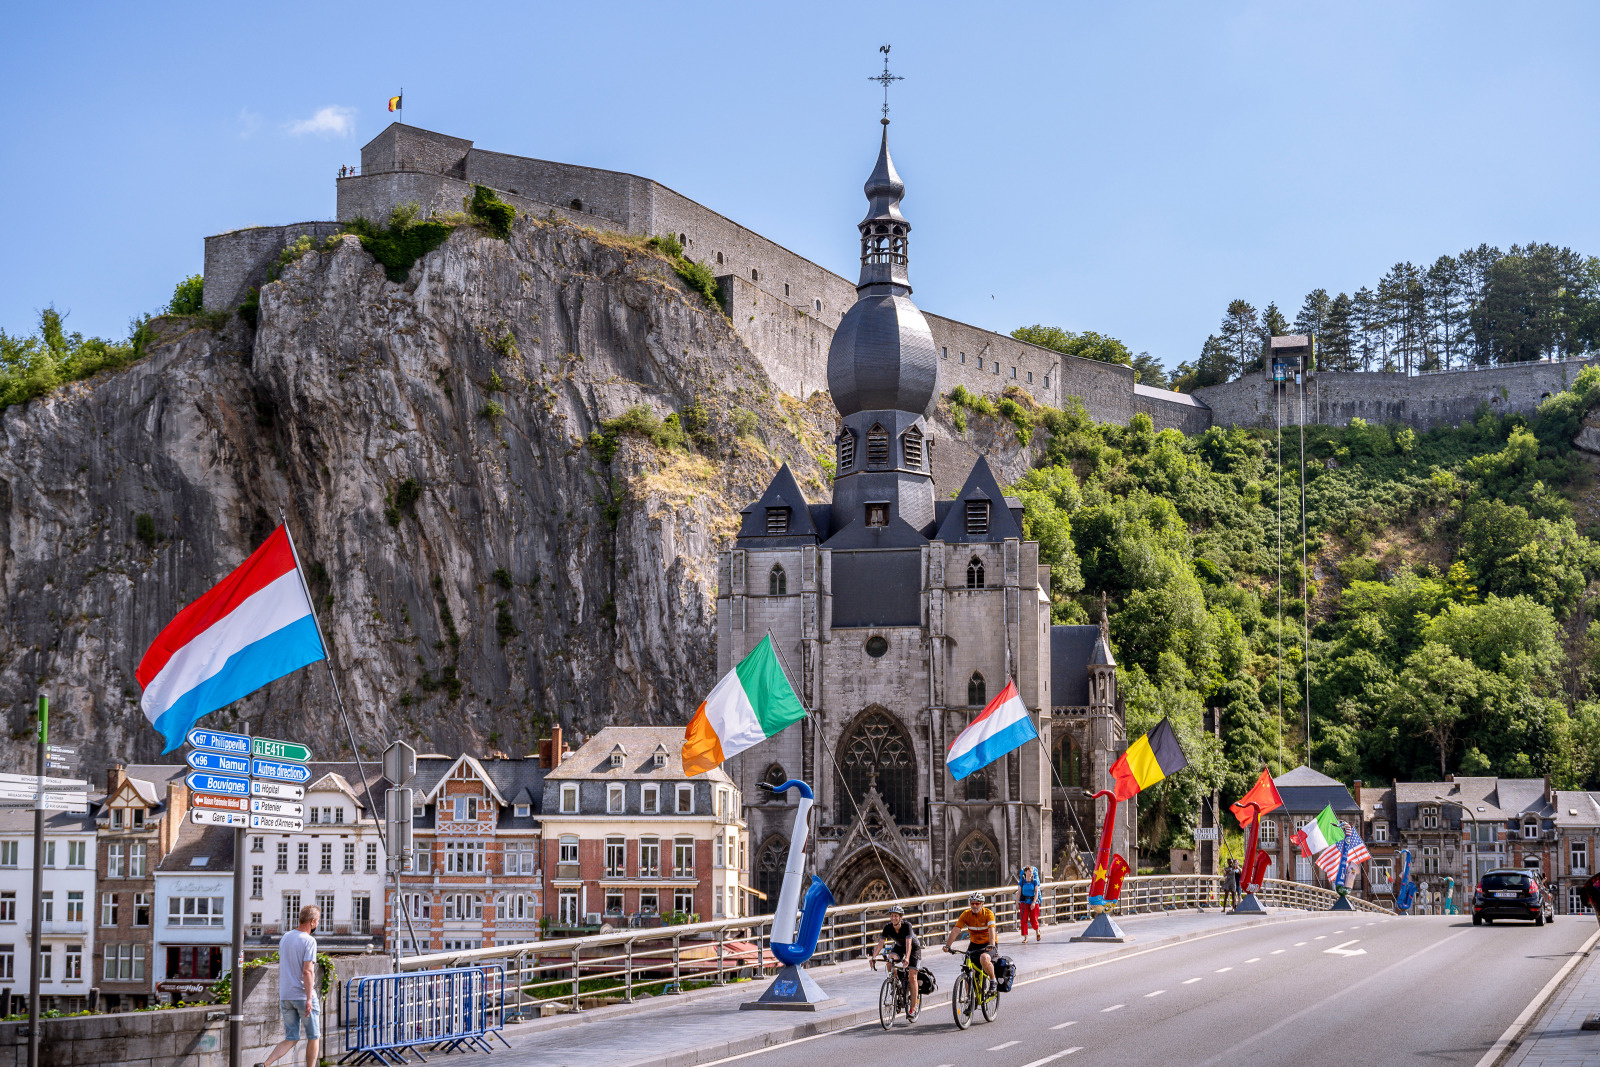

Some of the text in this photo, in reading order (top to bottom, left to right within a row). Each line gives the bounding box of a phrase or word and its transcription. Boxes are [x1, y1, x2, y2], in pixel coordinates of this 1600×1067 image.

[211, 735, 247, 751] Philippeville
[265, 743, 285, 757] E411
[219, 757, 247, 771] Namur
[257, 762, 304, 779] Autres directions
[207, 778, 245, 793] Bouvignes
[261, 783, 280, 794] Hôpital
[212, 812, 226, 822] Gare
[260, 817, 274, 827] Place
